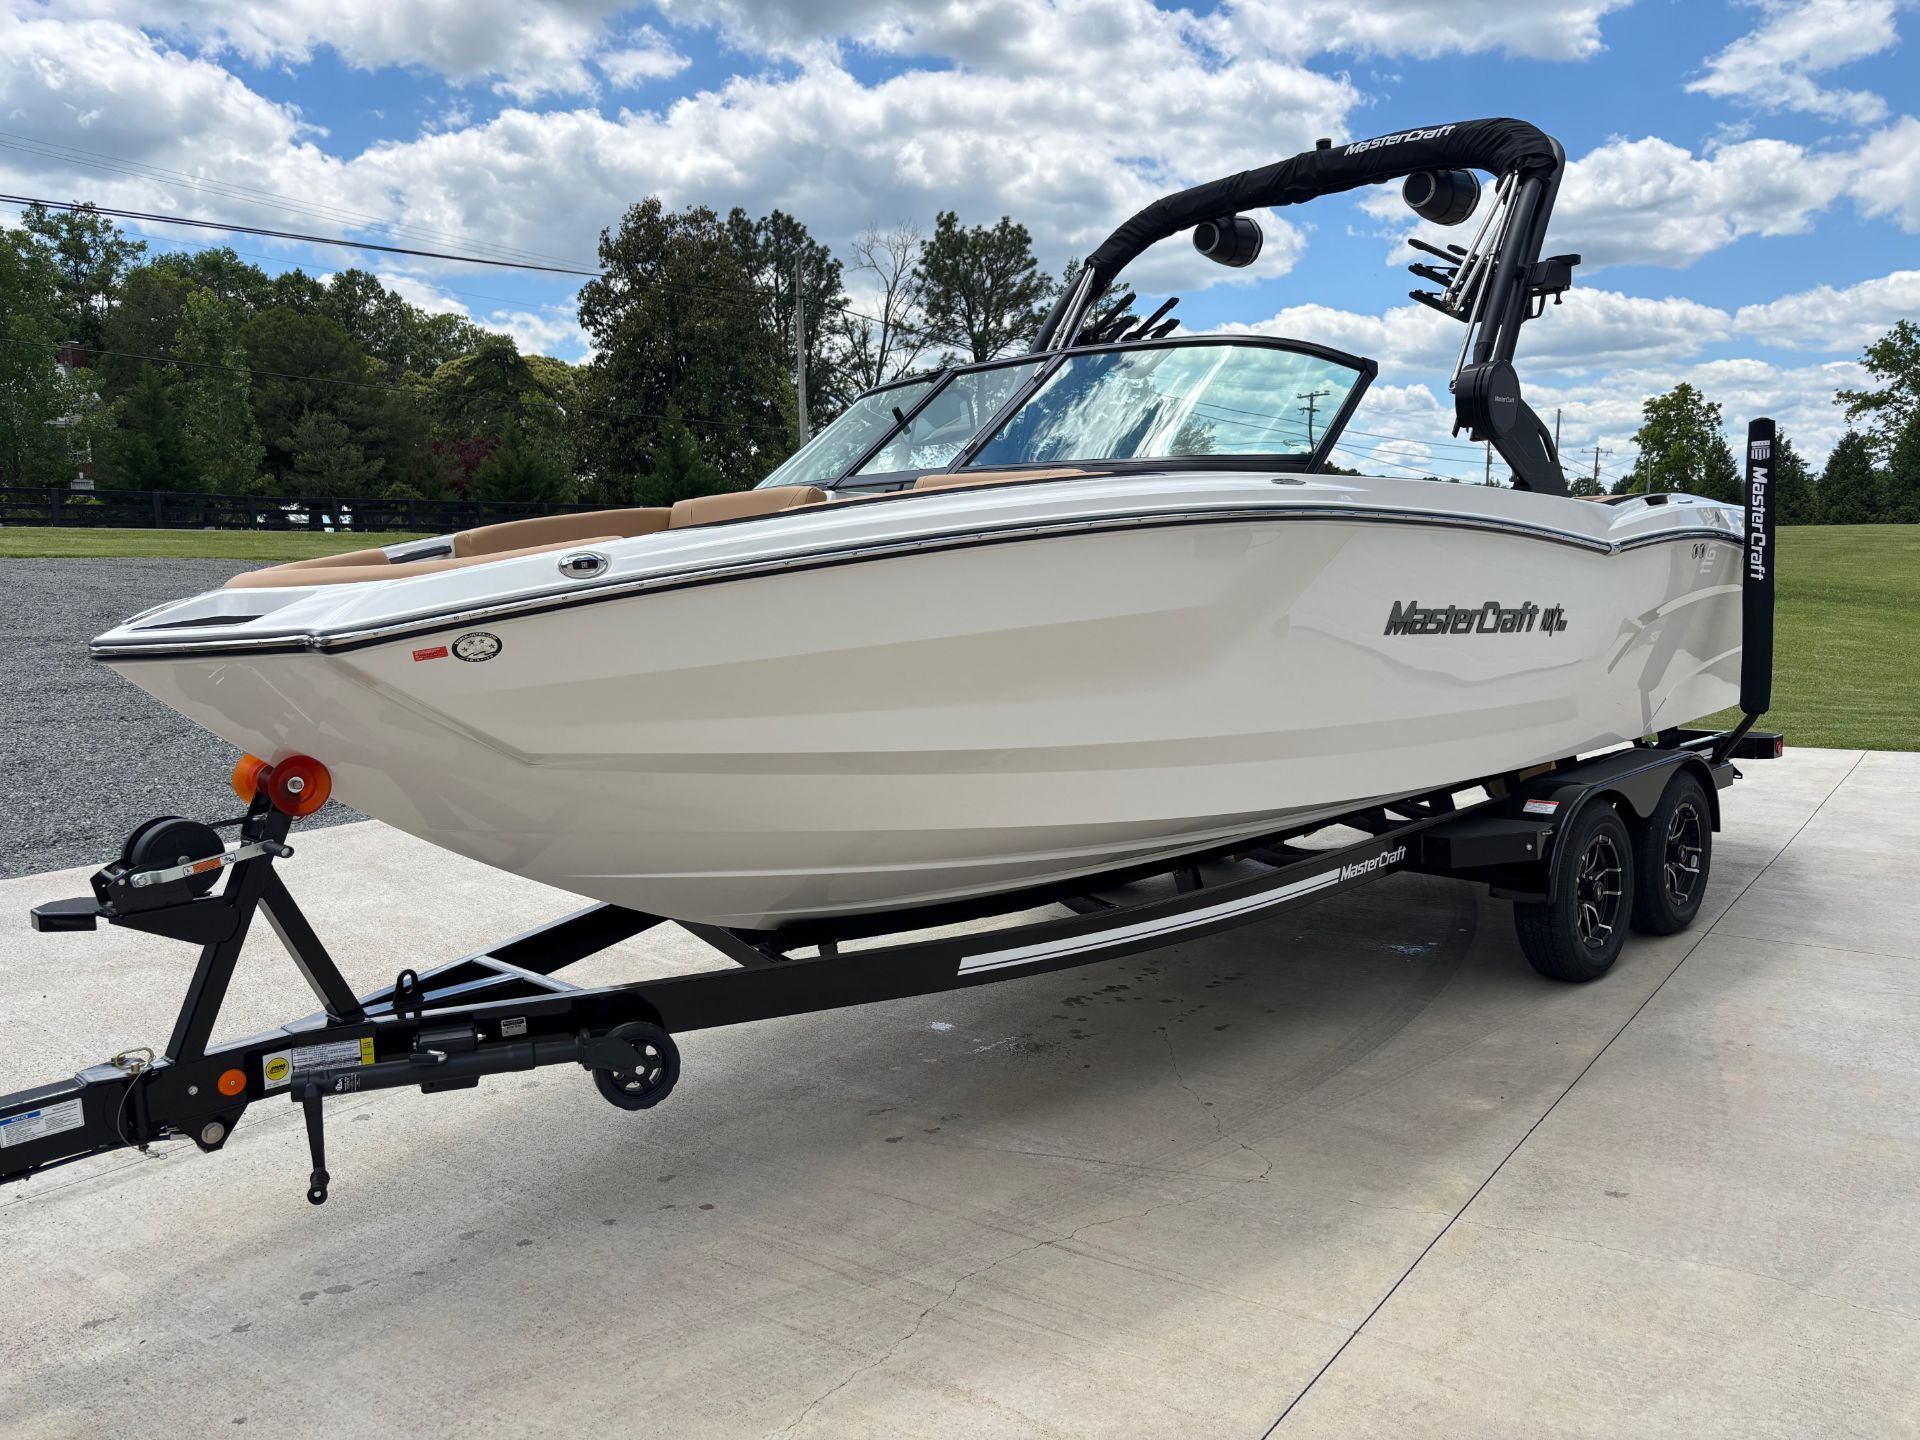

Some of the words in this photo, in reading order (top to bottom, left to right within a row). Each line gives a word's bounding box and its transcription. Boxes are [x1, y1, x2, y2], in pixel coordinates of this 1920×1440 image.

[1344, 124, 1456, 157] MasterCraft
[1750, 466, 1768, 580] MasterCraft
[1383, 600, 1540, 636] MasterCraft
[1341, 845, 1407, 882] MasterCraft
